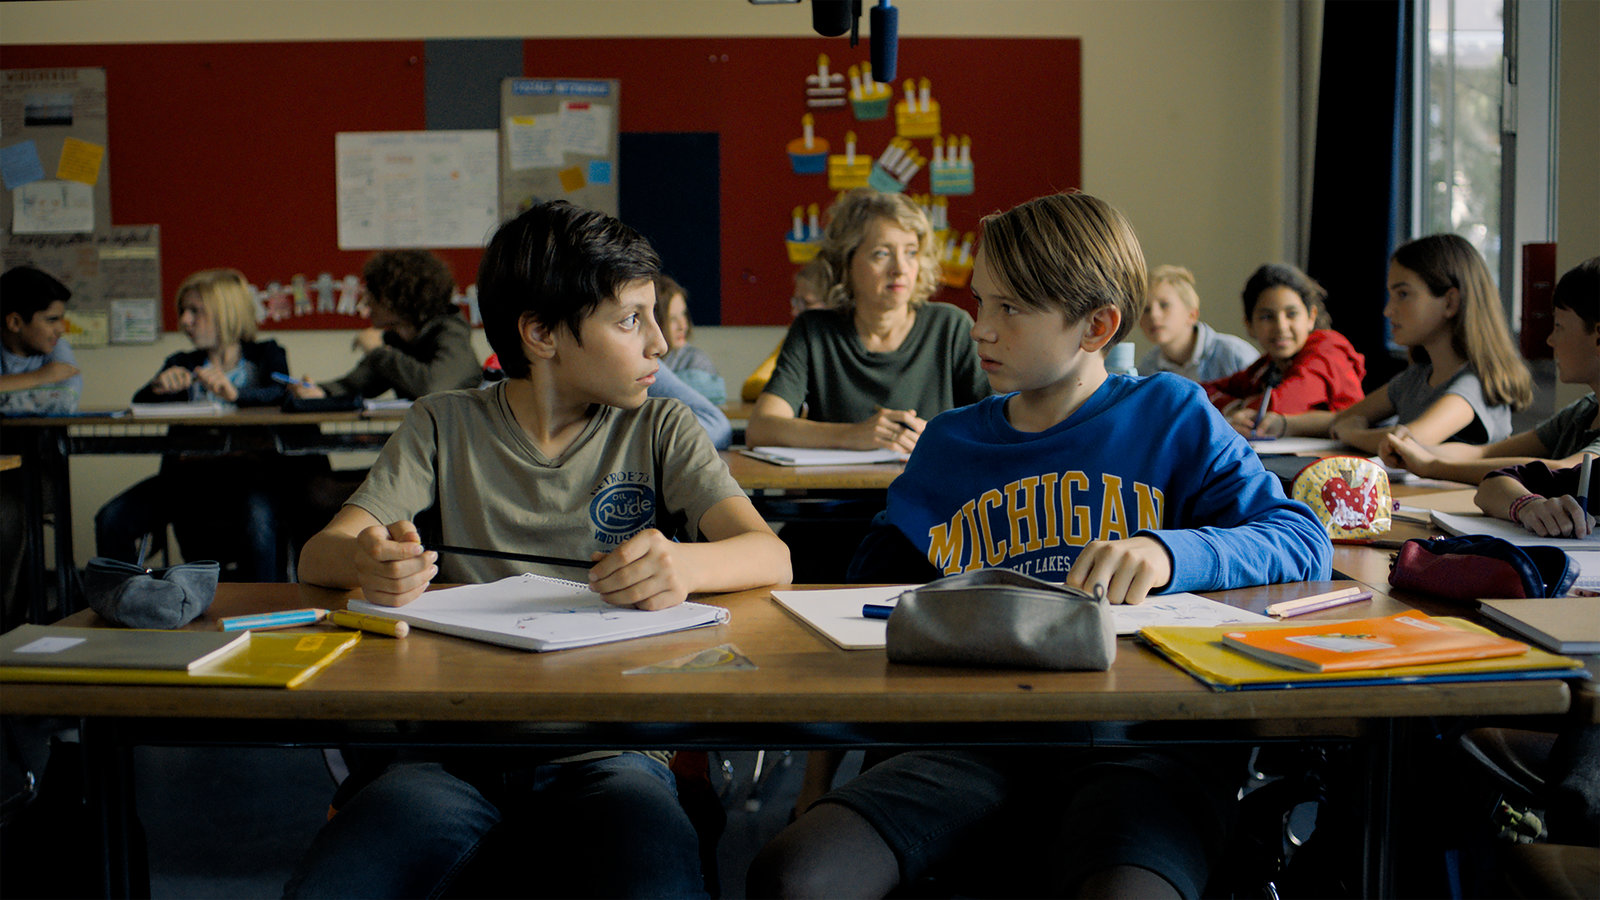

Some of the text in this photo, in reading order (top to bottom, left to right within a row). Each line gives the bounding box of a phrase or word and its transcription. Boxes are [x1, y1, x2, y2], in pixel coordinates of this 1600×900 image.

[612, 493, 627, 501] OIL
[928, 470, 1165, 576] MICHIGAN
[1034, 555, 1071, 574] LAKES
